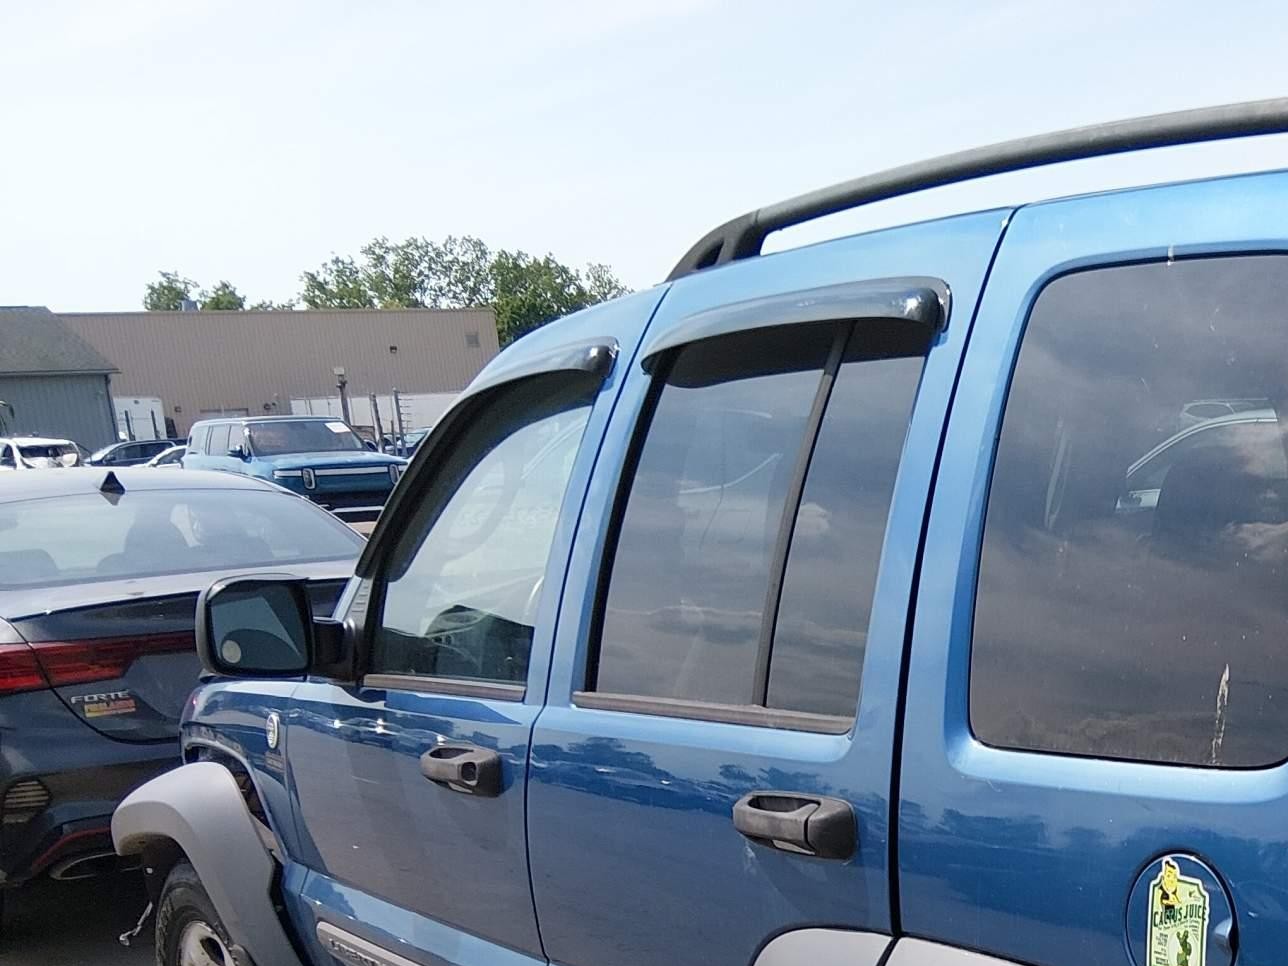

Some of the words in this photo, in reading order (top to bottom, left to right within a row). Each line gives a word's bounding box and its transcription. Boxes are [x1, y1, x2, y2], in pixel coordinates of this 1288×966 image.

[70, 689, 130, 704] FORTE
[1153, 905, 1183, 928] CACTUS
[1184, 902, 1208, 921] JUICE
